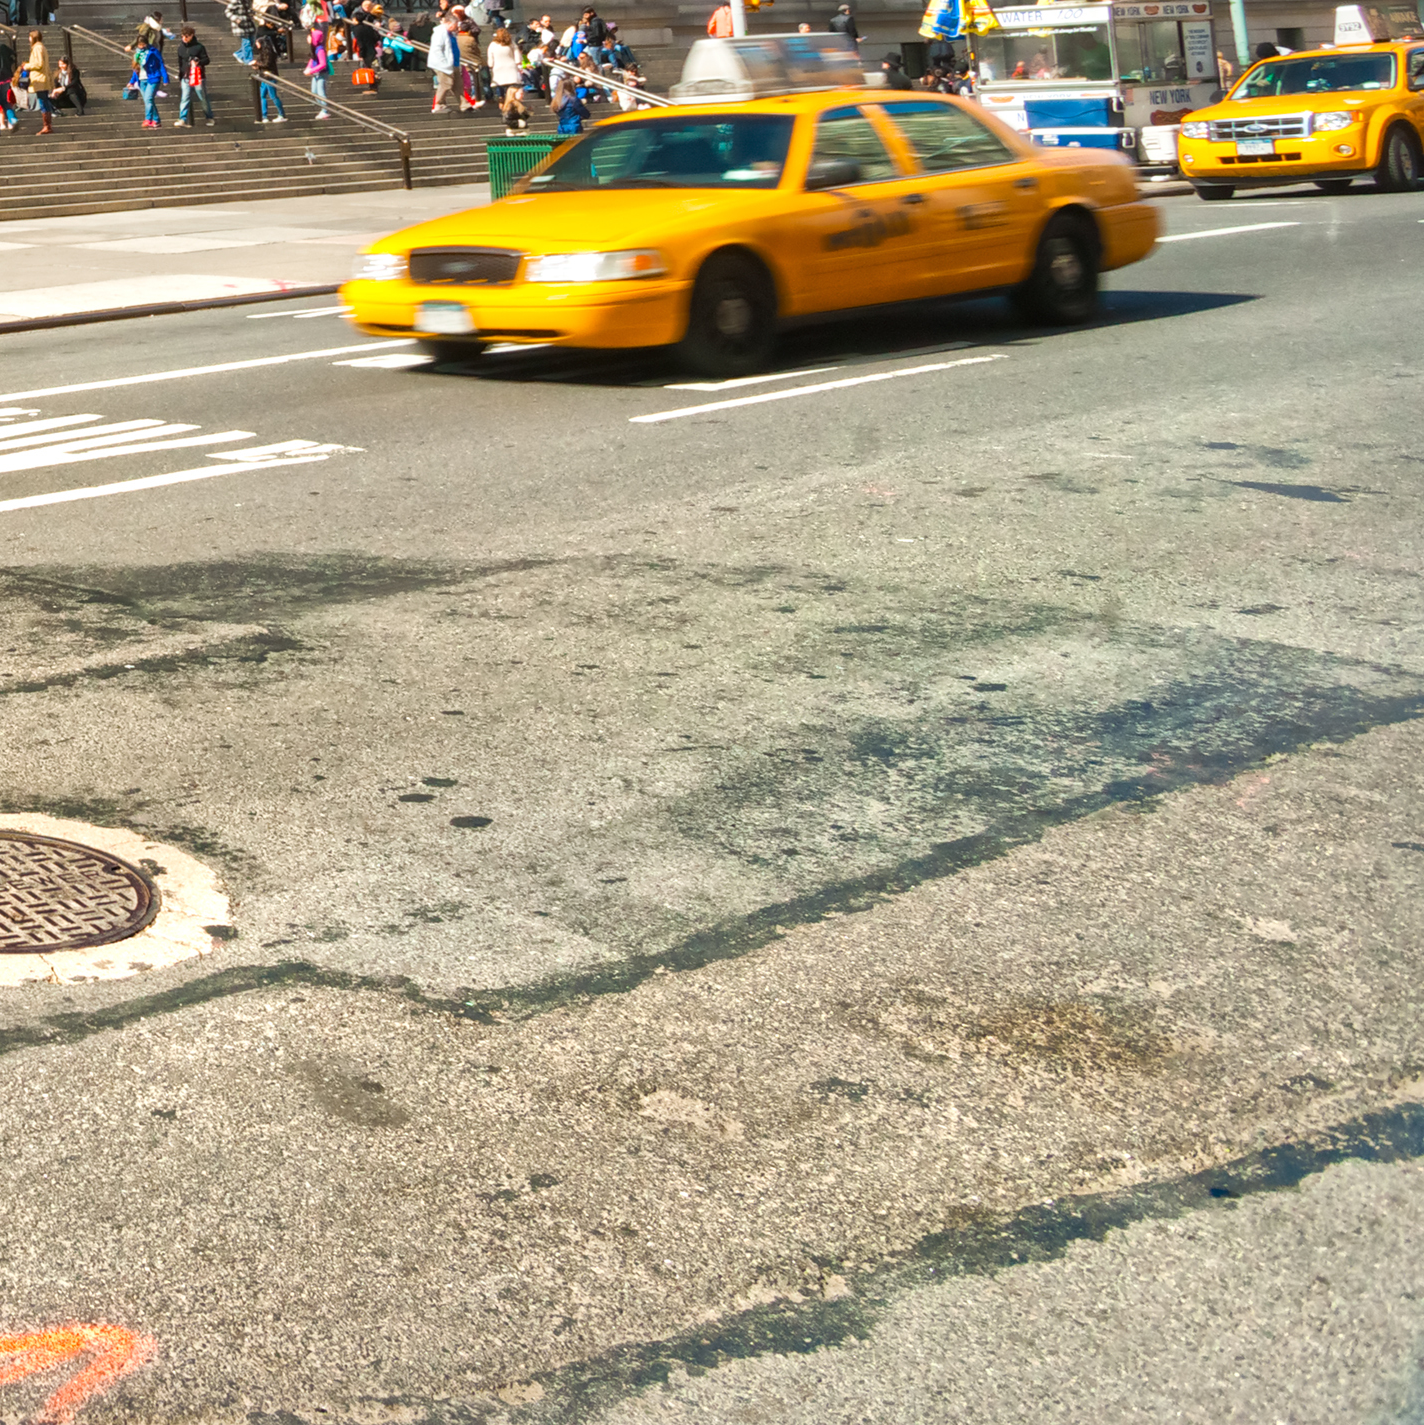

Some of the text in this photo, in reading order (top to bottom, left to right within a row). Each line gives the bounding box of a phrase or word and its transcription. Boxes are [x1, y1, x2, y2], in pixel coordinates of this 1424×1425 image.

[1113, 6, 1141, 16] NEW YORK
[1162, 4, 1190, 14] NEW YORK
[1001, 10, 1043, 23] WATER
[1149, 88, 1192, 105] NEW YORK
